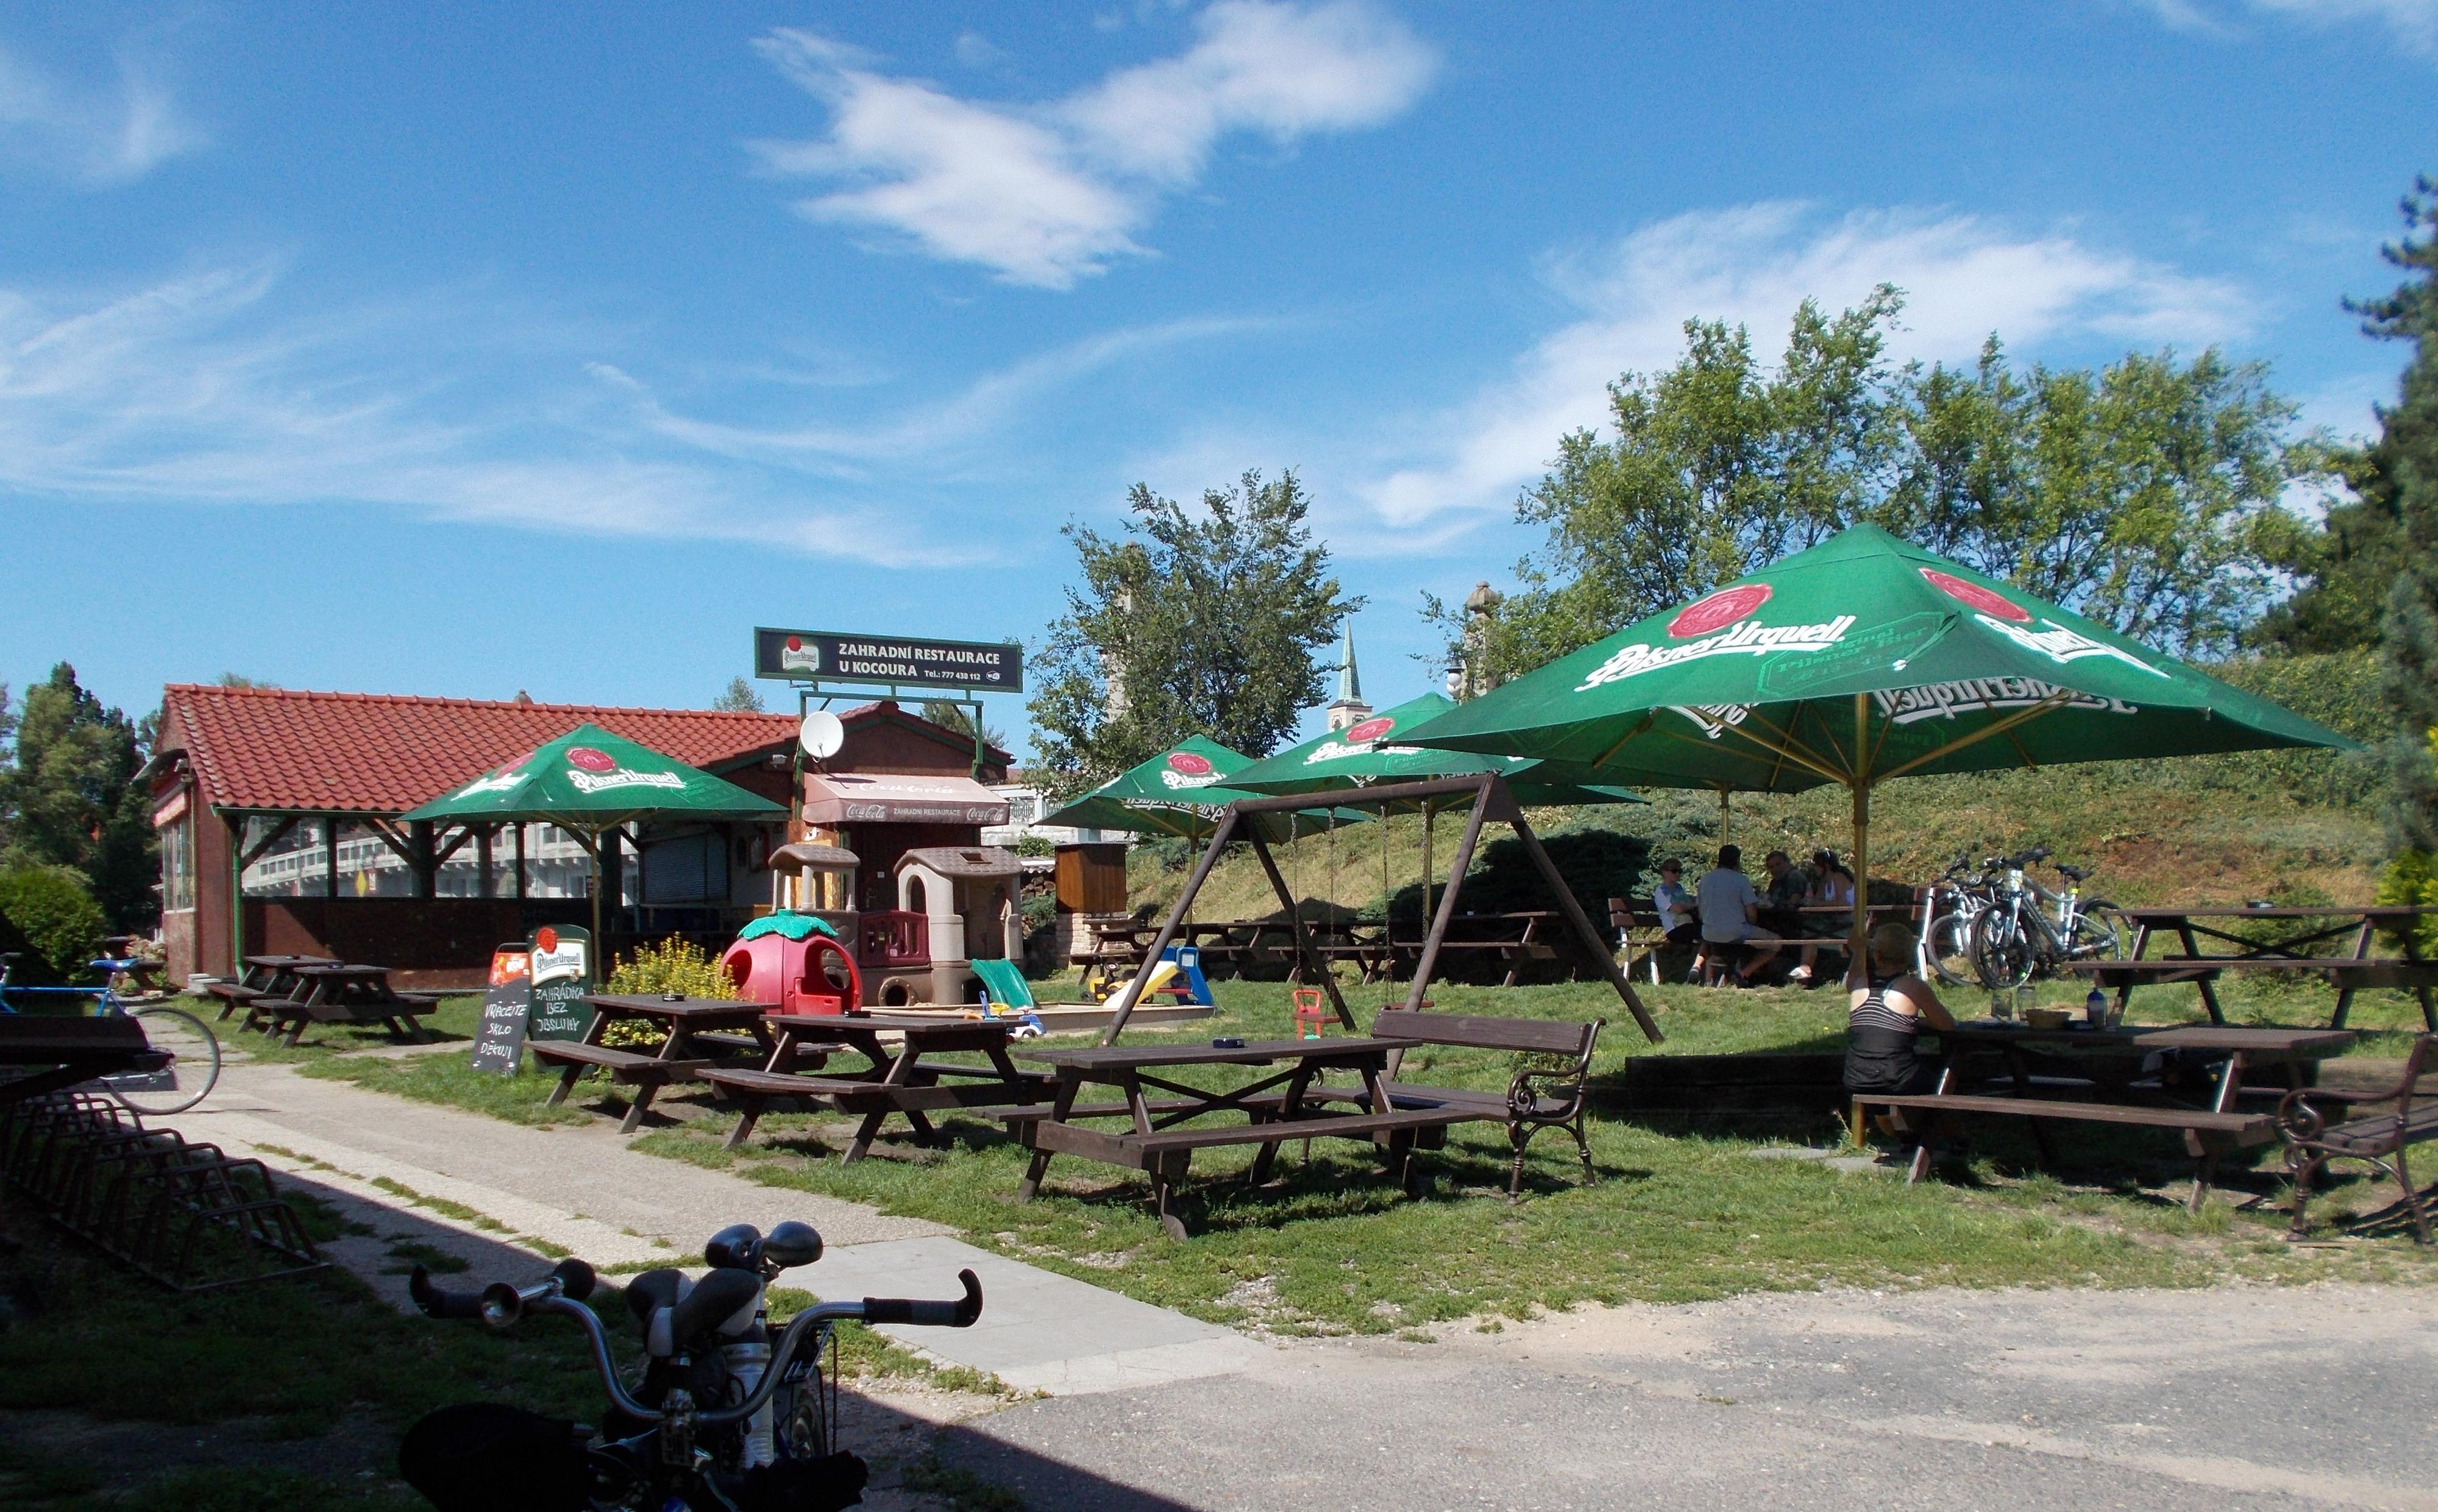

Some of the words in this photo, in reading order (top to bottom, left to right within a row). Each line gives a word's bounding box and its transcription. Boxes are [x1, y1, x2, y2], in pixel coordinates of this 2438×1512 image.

[839, 644, 911, 659] ZAHRADNÍ
[915, 648, 1000, 665] RESTAURACE
[1574, 634, 1727, 692] Pilsner
[839, 661, 849, 672] U
[853, 661, 917, 676] KOCOURA
[567, 770, 630, 793] Pilsner
[923, 808, 961, 817] RESTAURACE
[537, 953, 559, 973] Pilsner
[558, 952, 580, 967] Urquell
[547, 1002, 568, 1015] BEZ
[486, 1023, 511, 1035] SKLO
